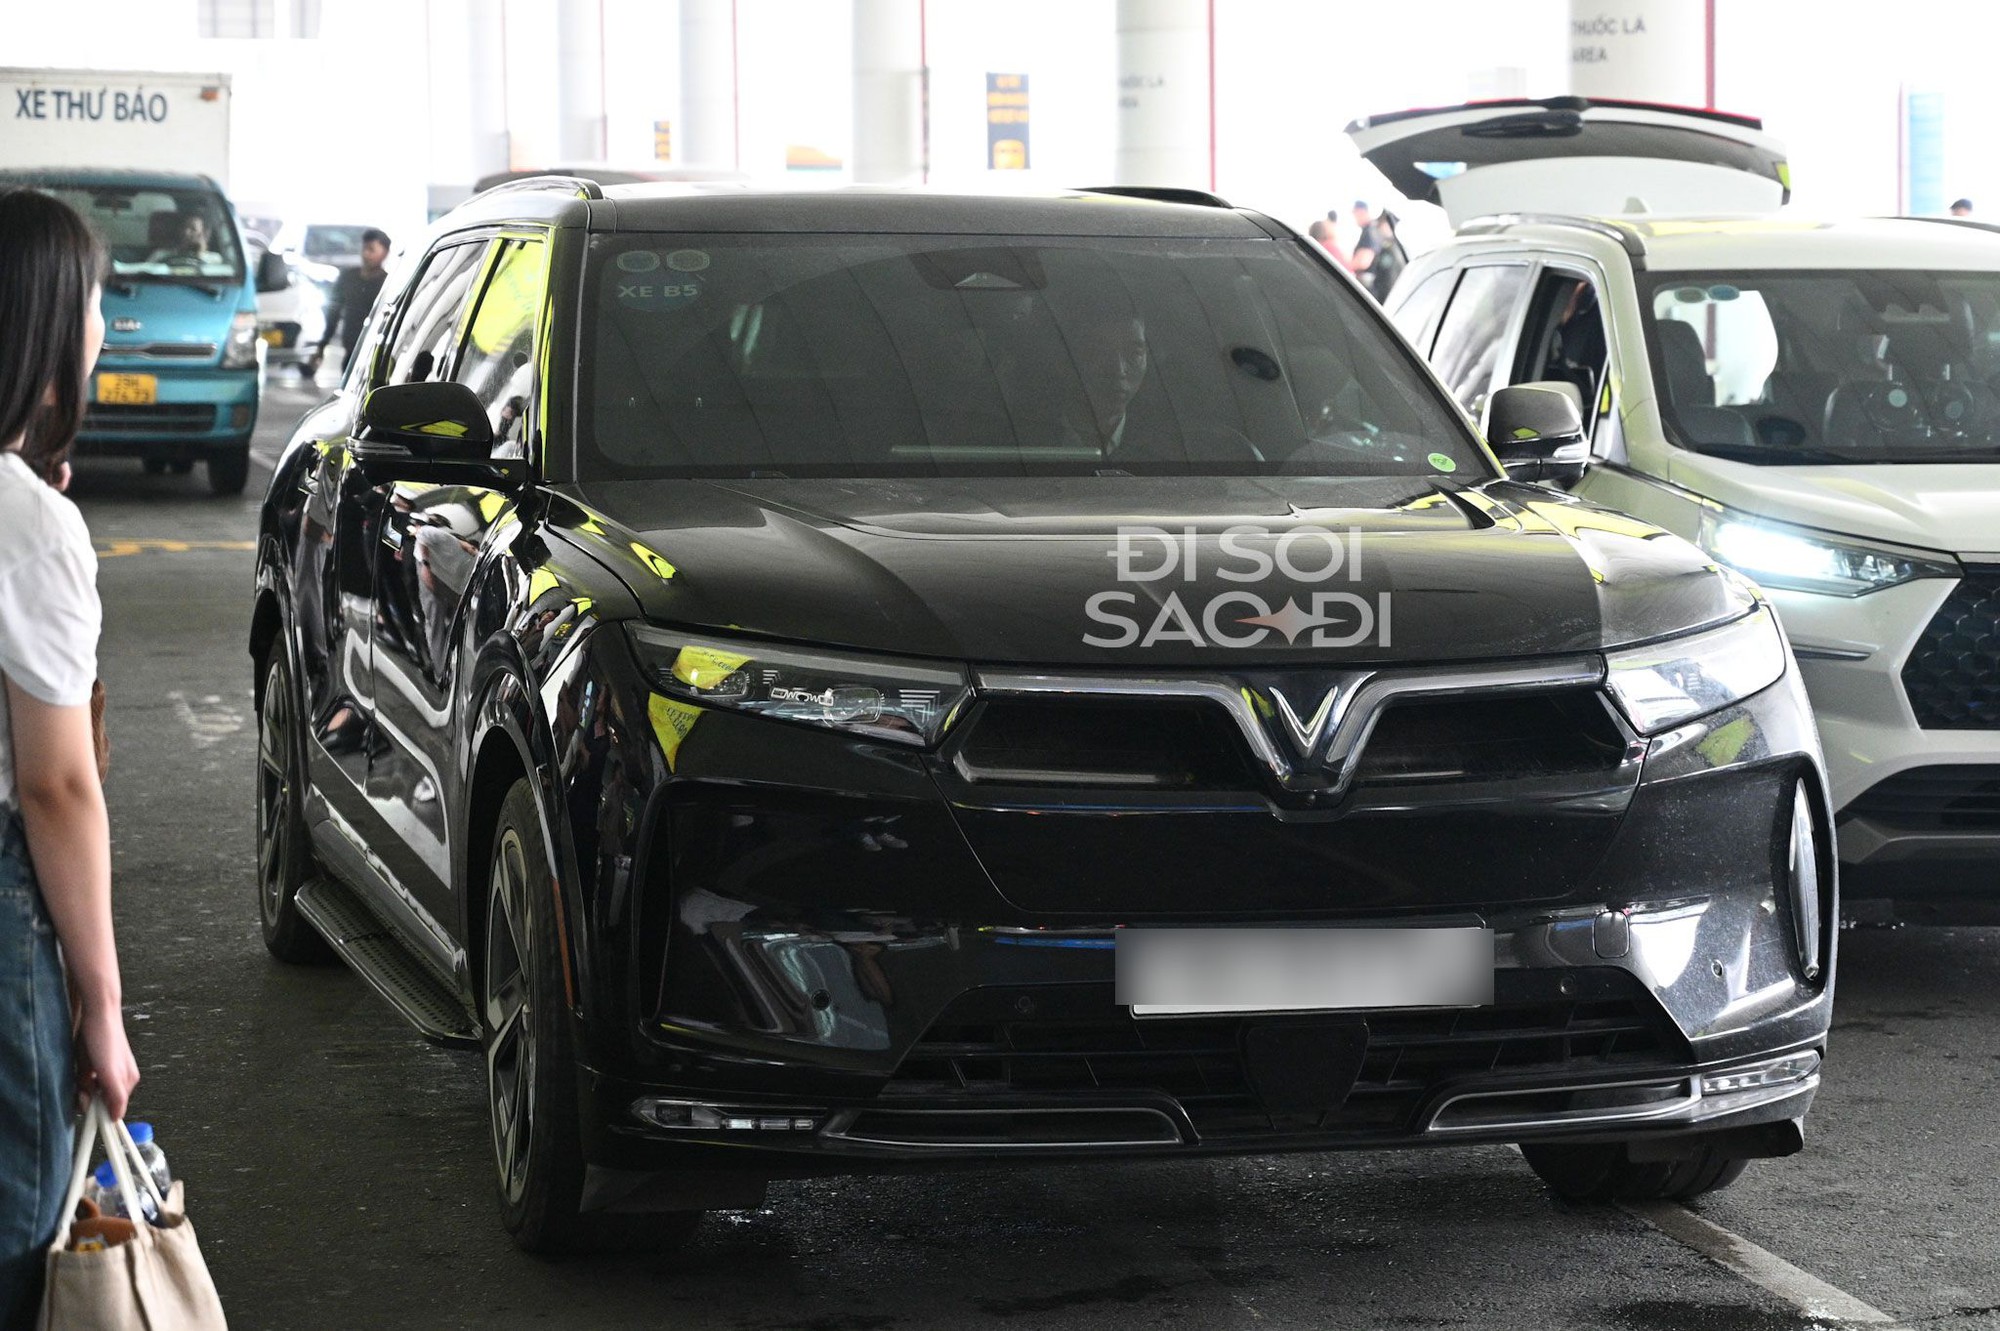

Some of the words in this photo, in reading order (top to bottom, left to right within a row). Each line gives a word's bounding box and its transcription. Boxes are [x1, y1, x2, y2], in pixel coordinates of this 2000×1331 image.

[16, 89, 46, 118] XE
[51, 85, 107, 120] THƯ
[114, 84, 168, 123] BÁO
[618, 285, 654, 298] XE
[663, 283, 699, 298] B5
